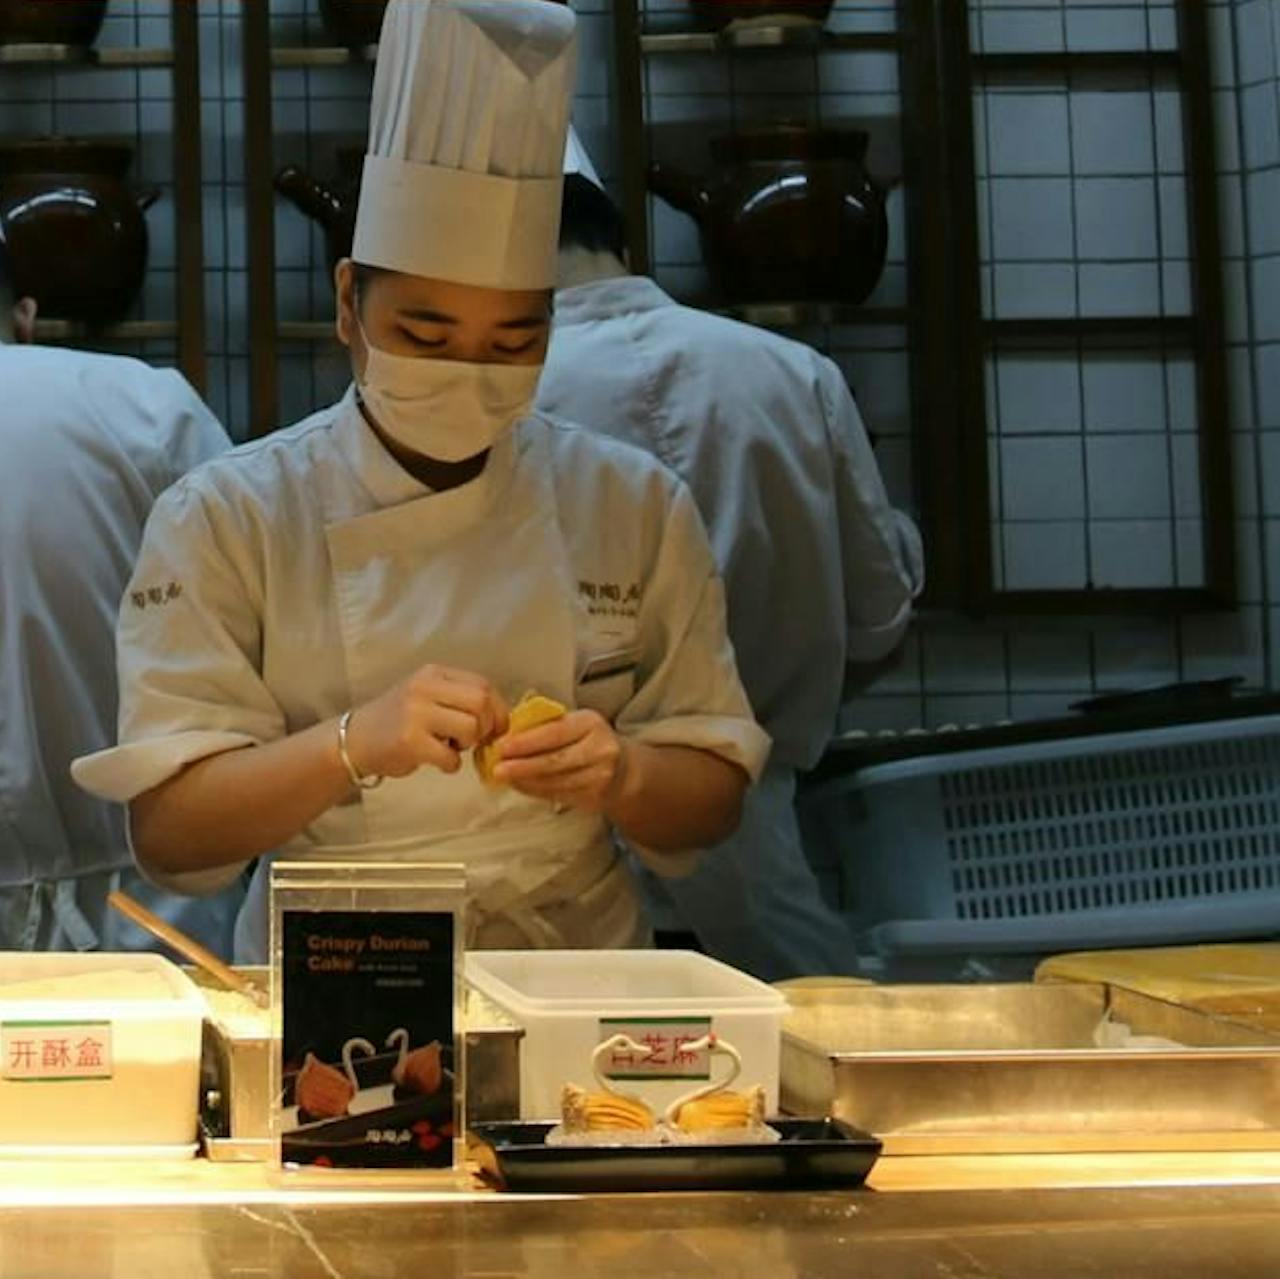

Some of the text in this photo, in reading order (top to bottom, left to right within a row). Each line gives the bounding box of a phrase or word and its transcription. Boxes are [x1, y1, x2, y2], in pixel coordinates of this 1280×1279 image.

[307, 934, 430, 954] Crispy Durian
[9, 1037, 104, 1069] 开酥盒
